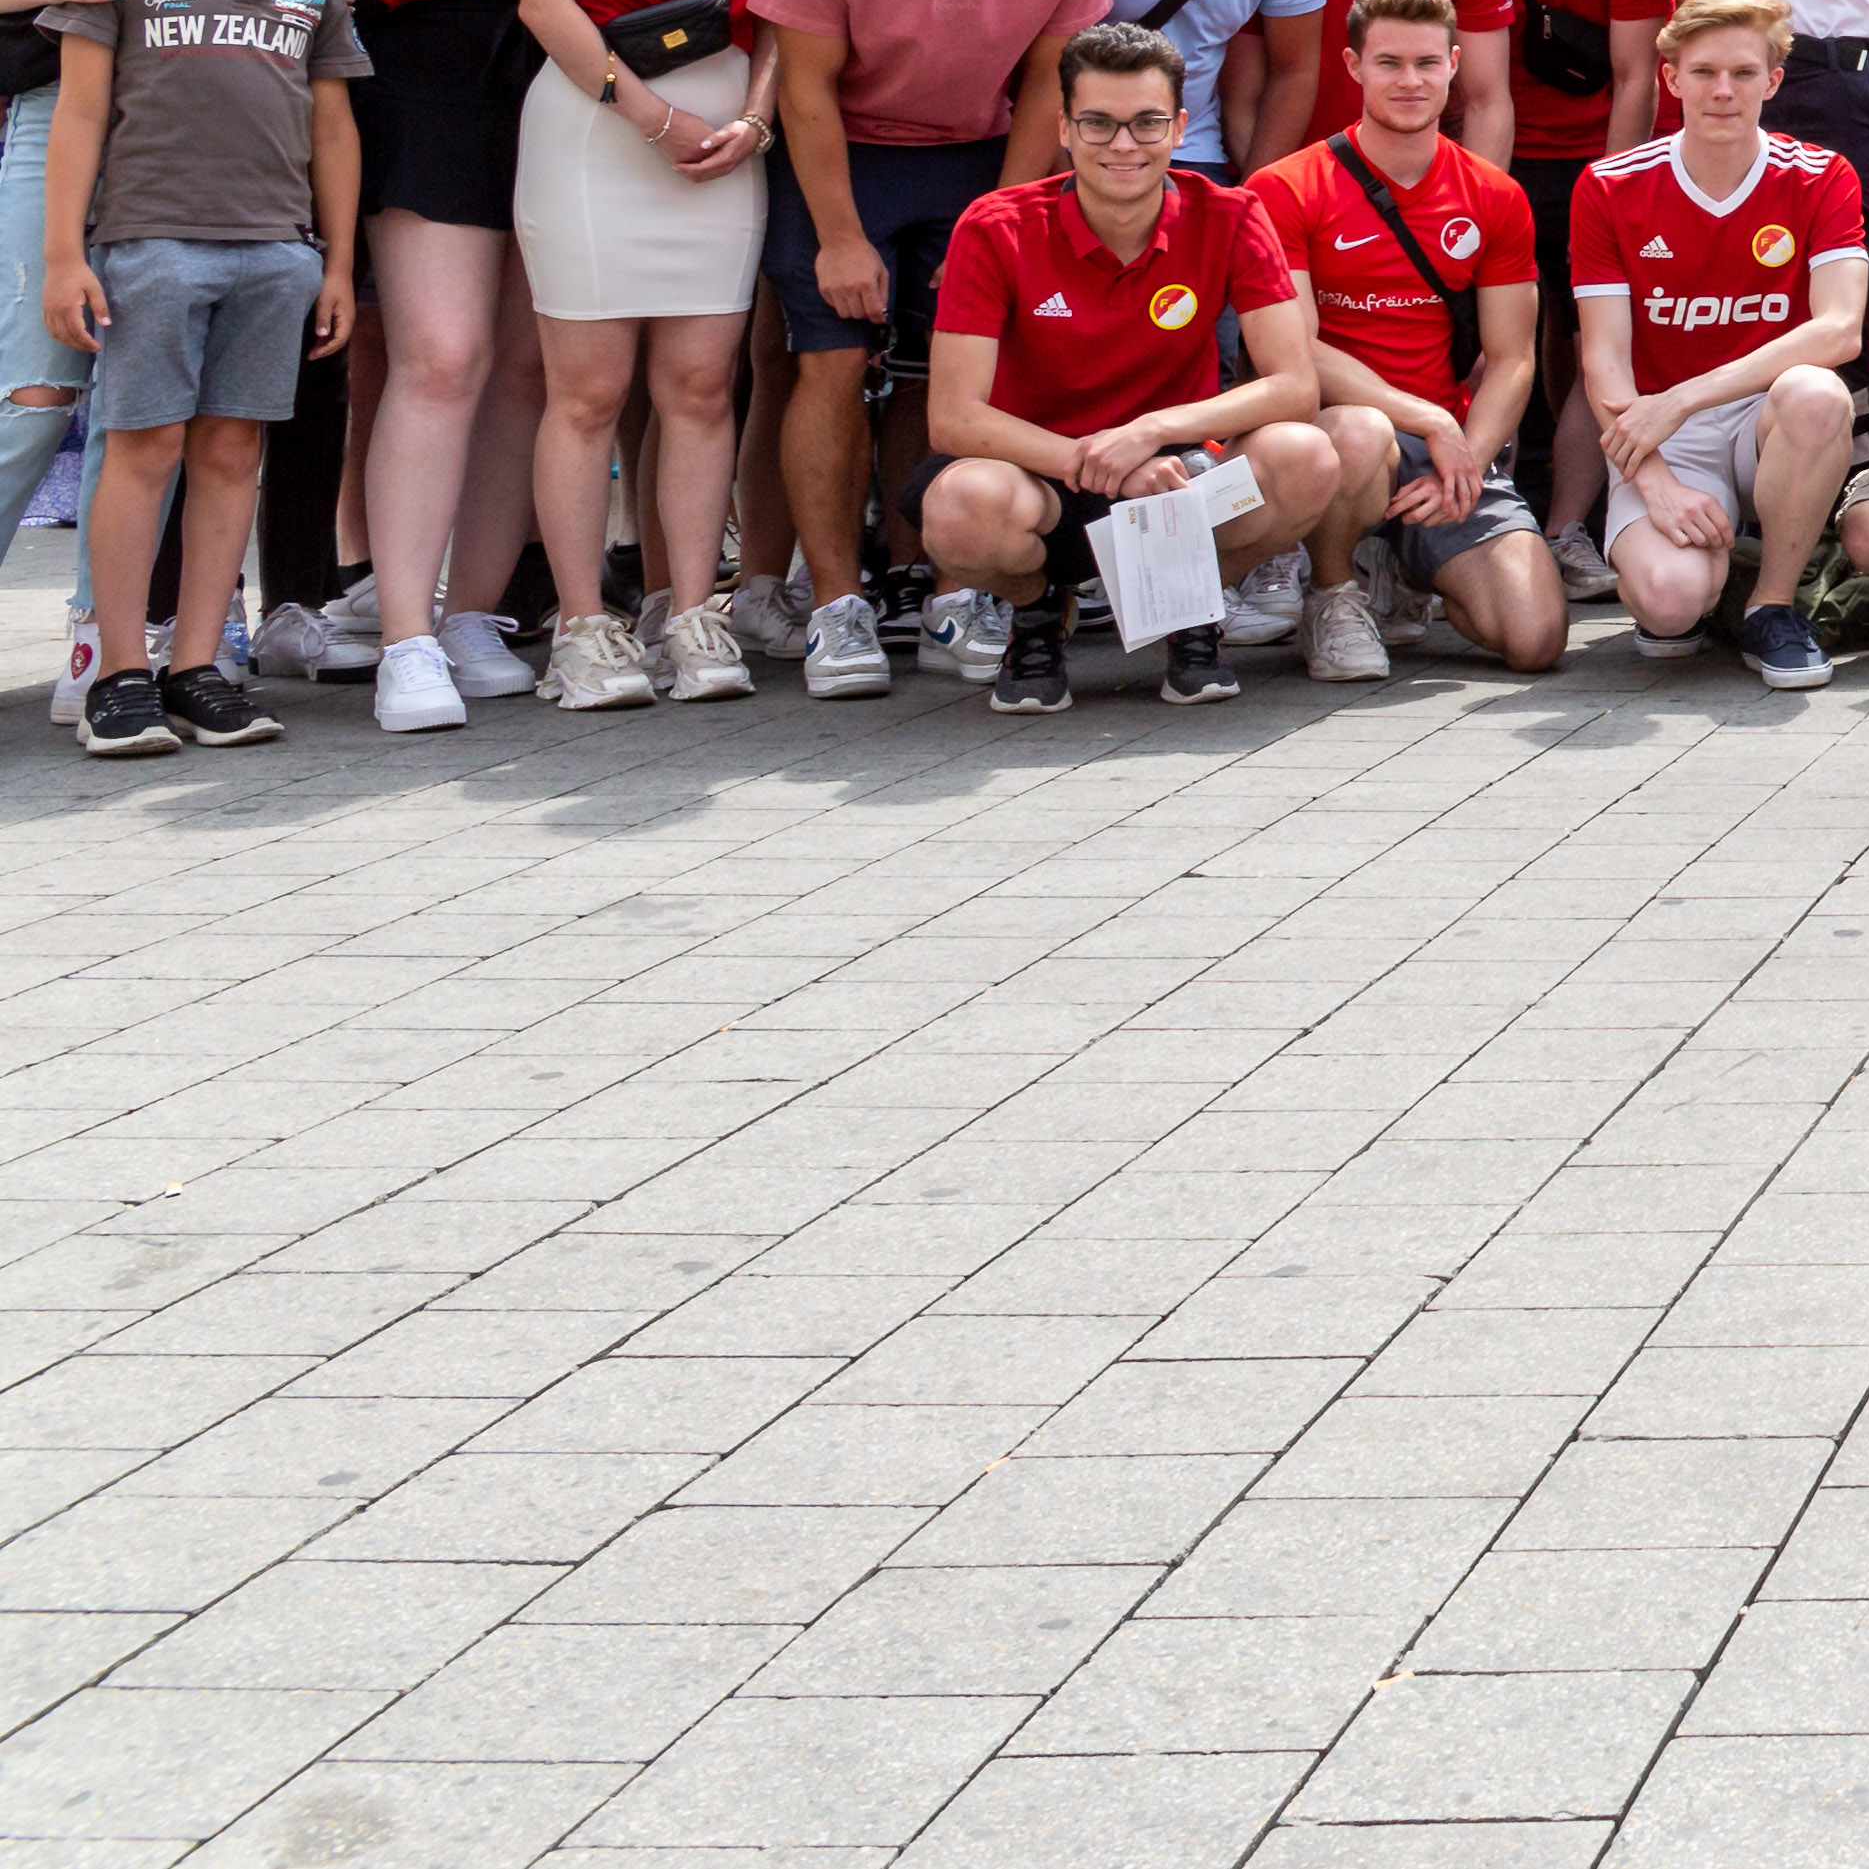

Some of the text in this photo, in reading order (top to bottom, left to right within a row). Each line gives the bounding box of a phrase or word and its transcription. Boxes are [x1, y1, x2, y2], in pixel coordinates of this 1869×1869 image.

[144, 15, 206, 48] NEW
[212, 14, 308, 60] ZEALAND
[1639, 248, 1674, 259] adidas
[1033, 308, 1073, 318] adidas
[1643, 286, 1790, 332] tipico
